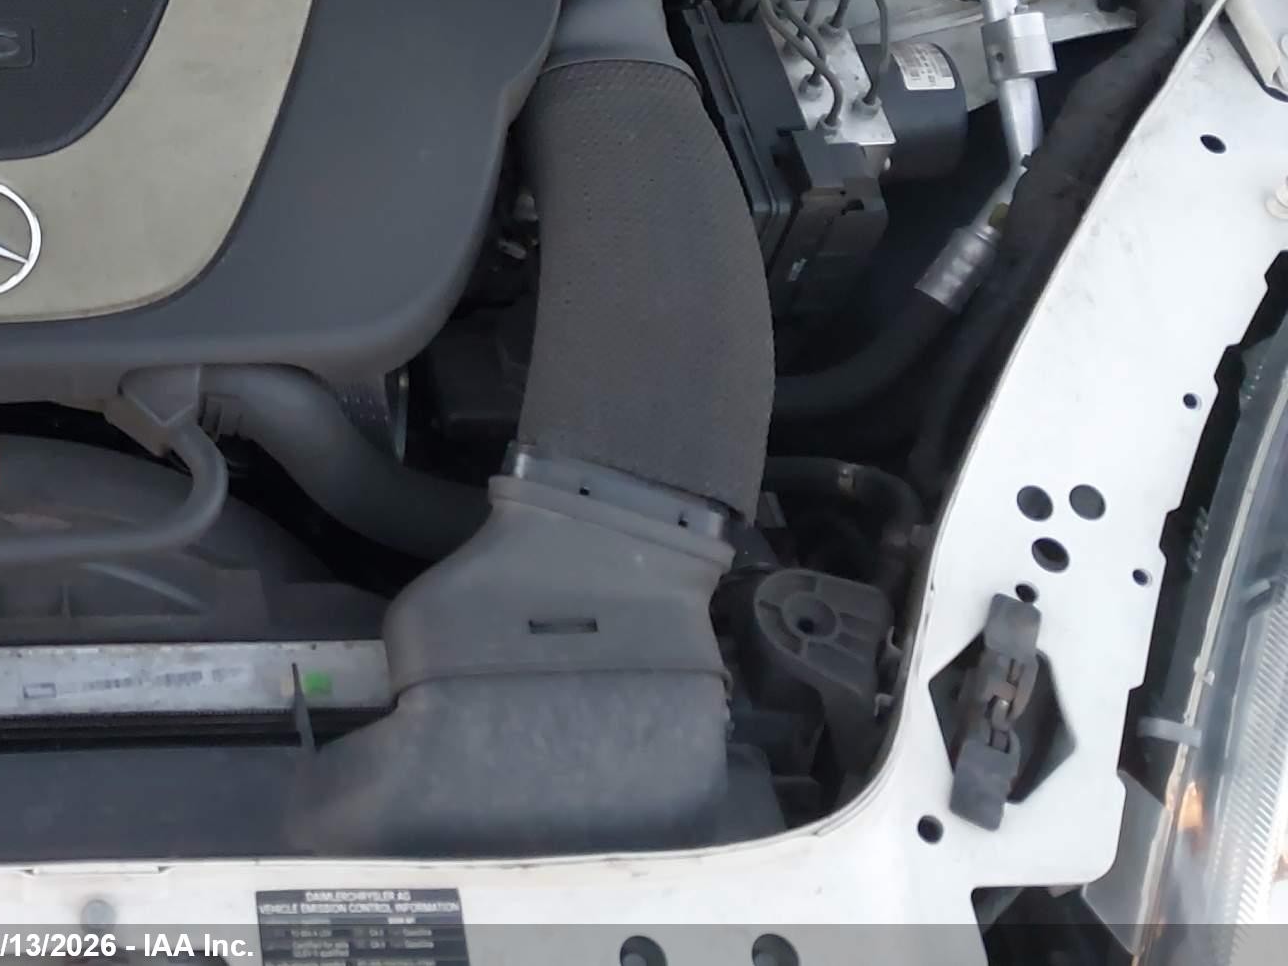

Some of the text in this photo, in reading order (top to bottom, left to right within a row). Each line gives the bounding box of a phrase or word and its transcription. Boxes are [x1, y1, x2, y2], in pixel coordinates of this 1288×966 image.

[259, 902, 460, 915] VEHICLE EMISSION CONTROL INFORMATION
